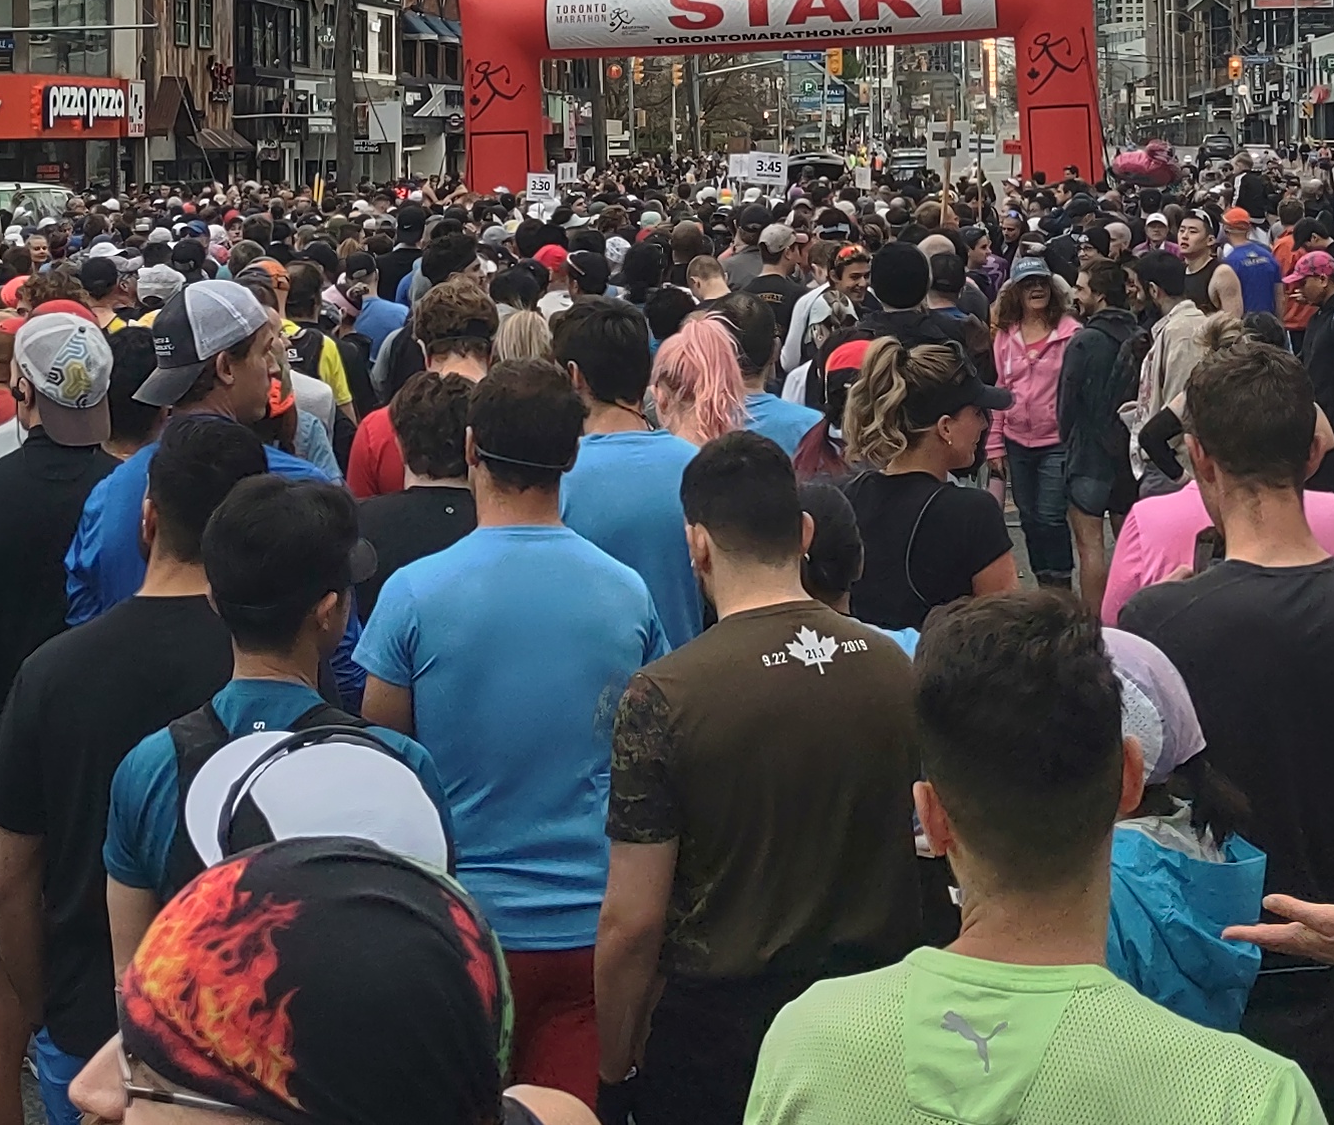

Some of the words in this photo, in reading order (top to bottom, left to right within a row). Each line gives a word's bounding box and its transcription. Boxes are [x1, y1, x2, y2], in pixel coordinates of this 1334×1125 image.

[555, 3, 608, 15] TORONTO
[555, 14, 608, 24] MARATHON
[653, 25, 893, 45] TORONTOMARATHON.COM
[50, 86, 87, 128] pizza
[89, 87, 125, 128] pizza
[755, 160, 782, 172] 3:45
[531, 181, 551, 192] 3:30
[841, 639, 868, 653] 2019
[762, 651, 788, 667] 9.22
[805, 647, 826, 659] 21.1
